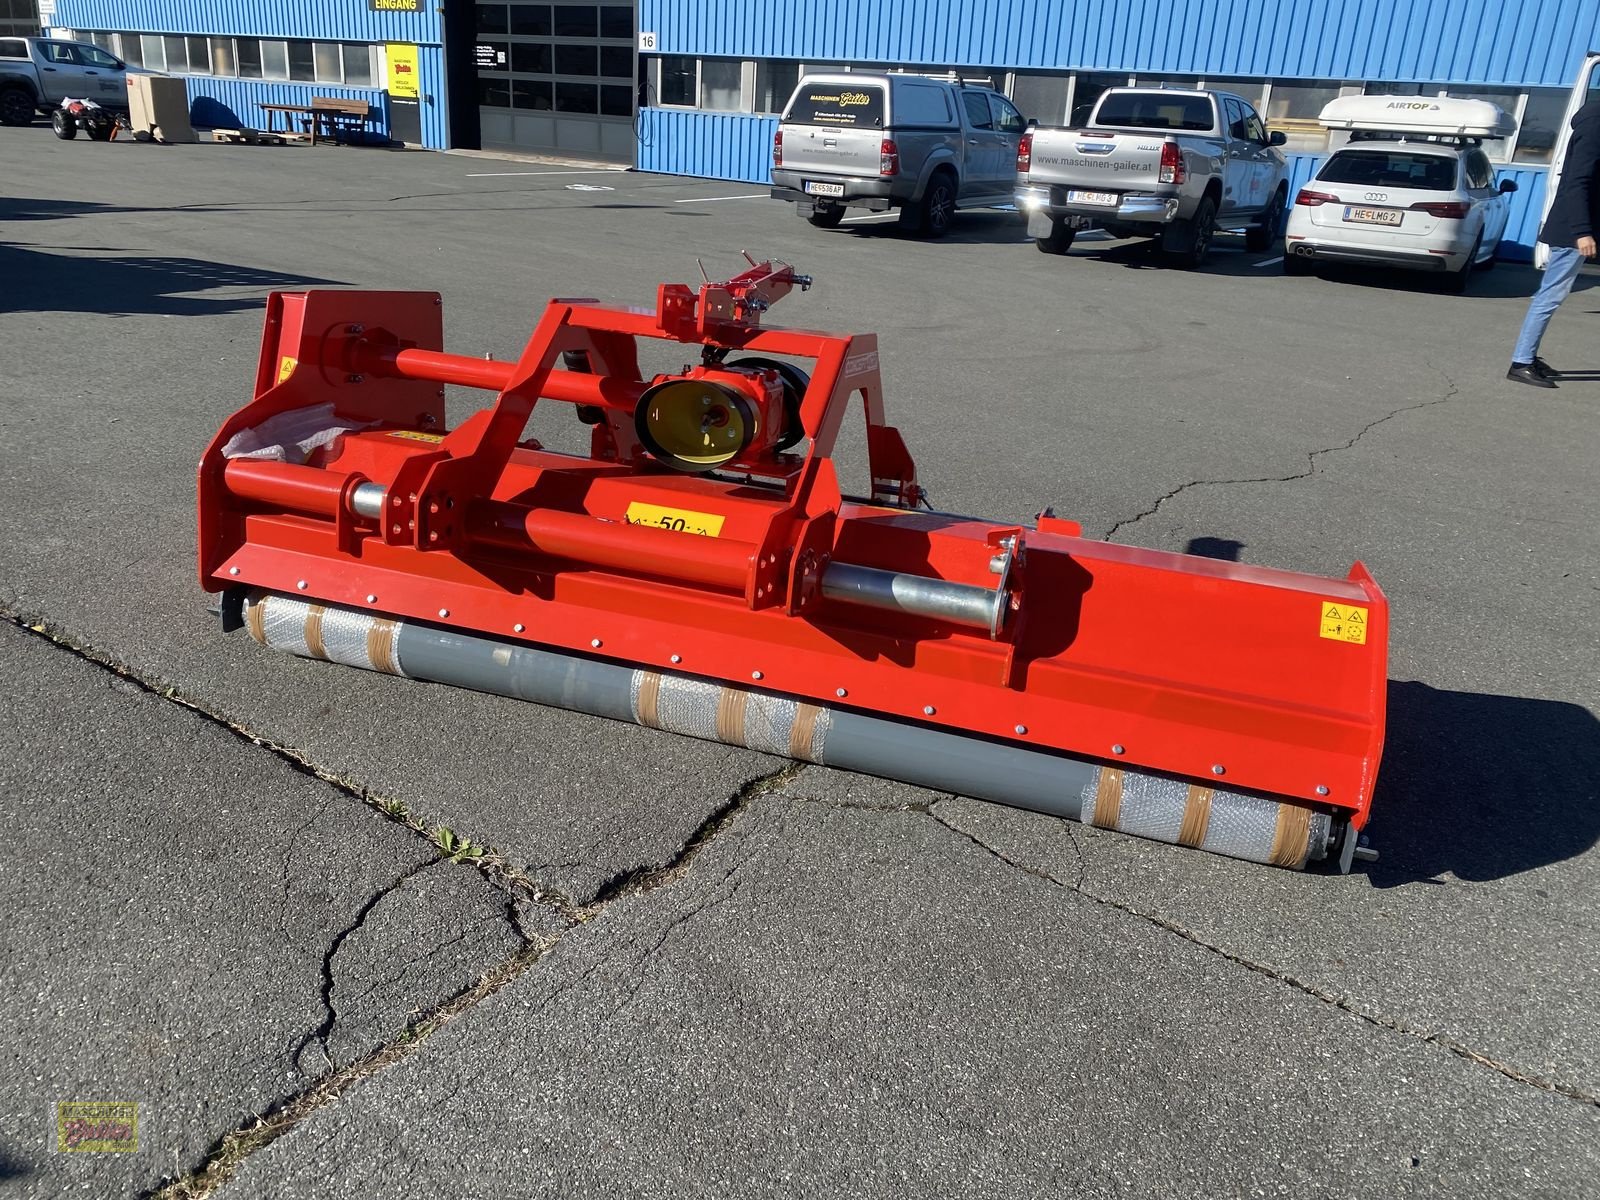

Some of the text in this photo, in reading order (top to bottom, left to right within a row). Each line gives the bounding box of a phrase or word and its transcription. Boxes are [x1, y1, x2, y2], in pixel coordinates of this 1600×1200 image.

[375, 0, 417, 9] EINGANG
[642, 35, 654, 48] 16
[840, 93, 869, 106] Gailer
[1386, 102, 1430, 110] AIRTOP
[1037, 155, 1153, 172] www.maschinen-gailer.at
[659, 516, 686, 532] 50
